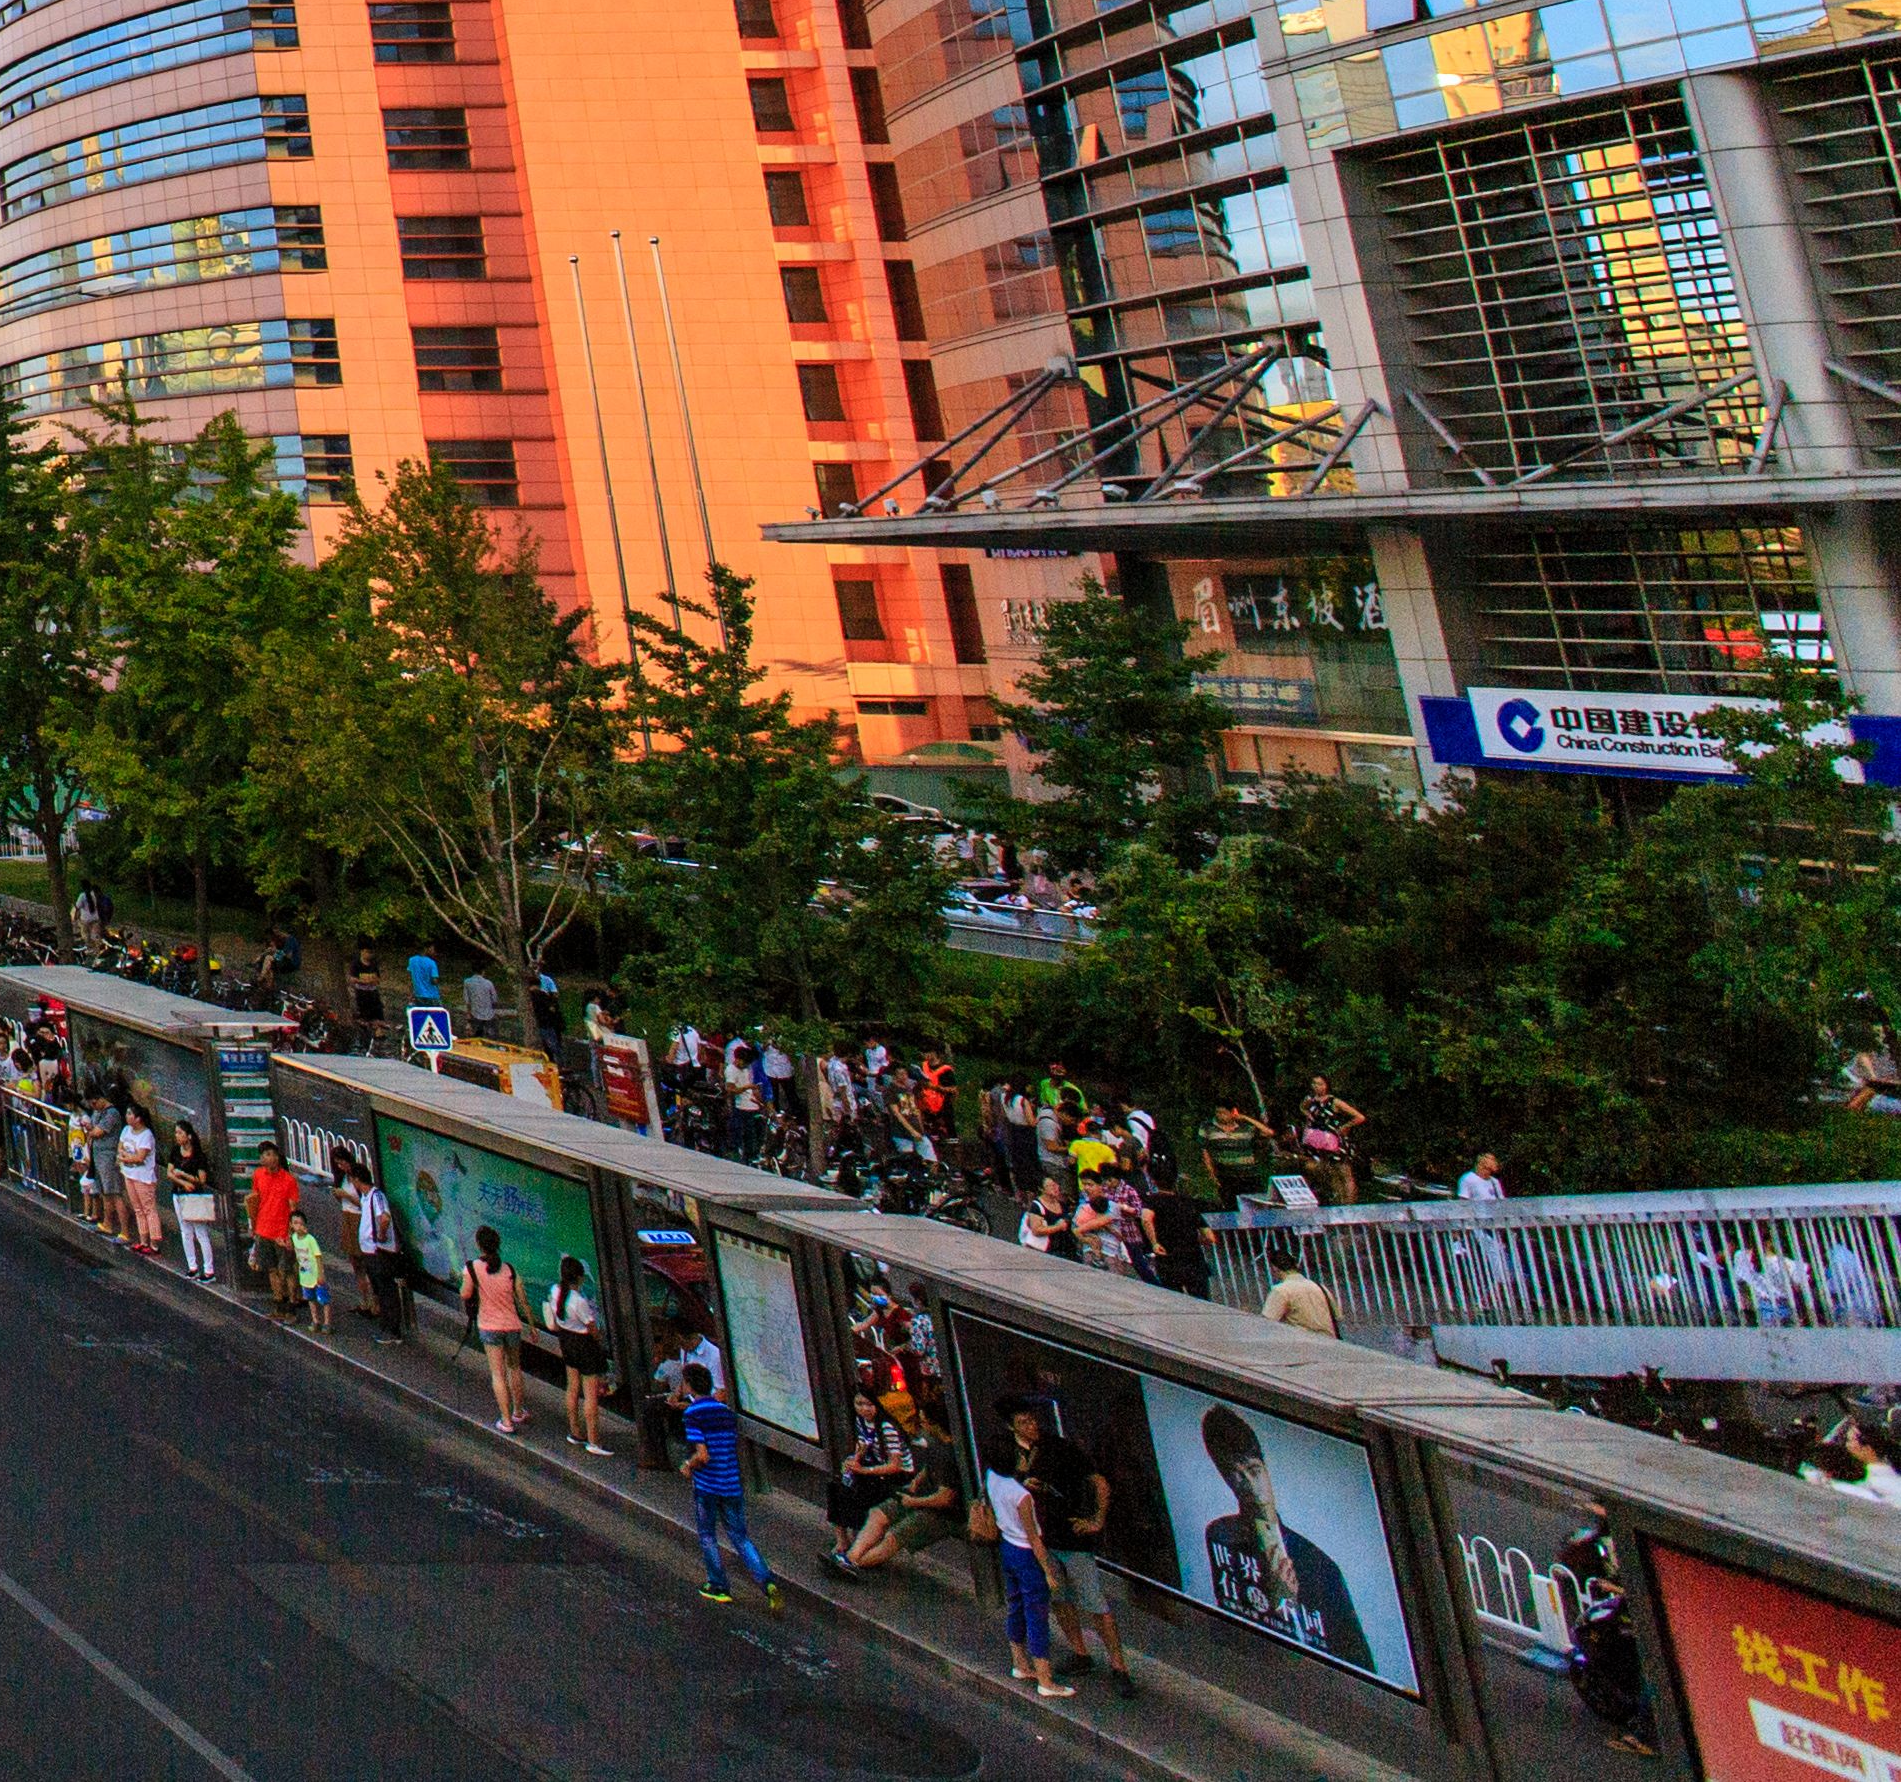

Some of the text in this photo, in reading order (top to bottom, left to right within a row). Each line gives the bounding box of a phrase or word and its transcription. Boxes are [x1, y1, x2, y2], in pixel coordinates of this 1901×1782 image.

[1556, 734, 1599, 750] China
[1600, 737, 1699, 757] Construction
[652, 1233, 688, 1242] TAXI
[1731, 1625, 1890, 1723] 找工作
